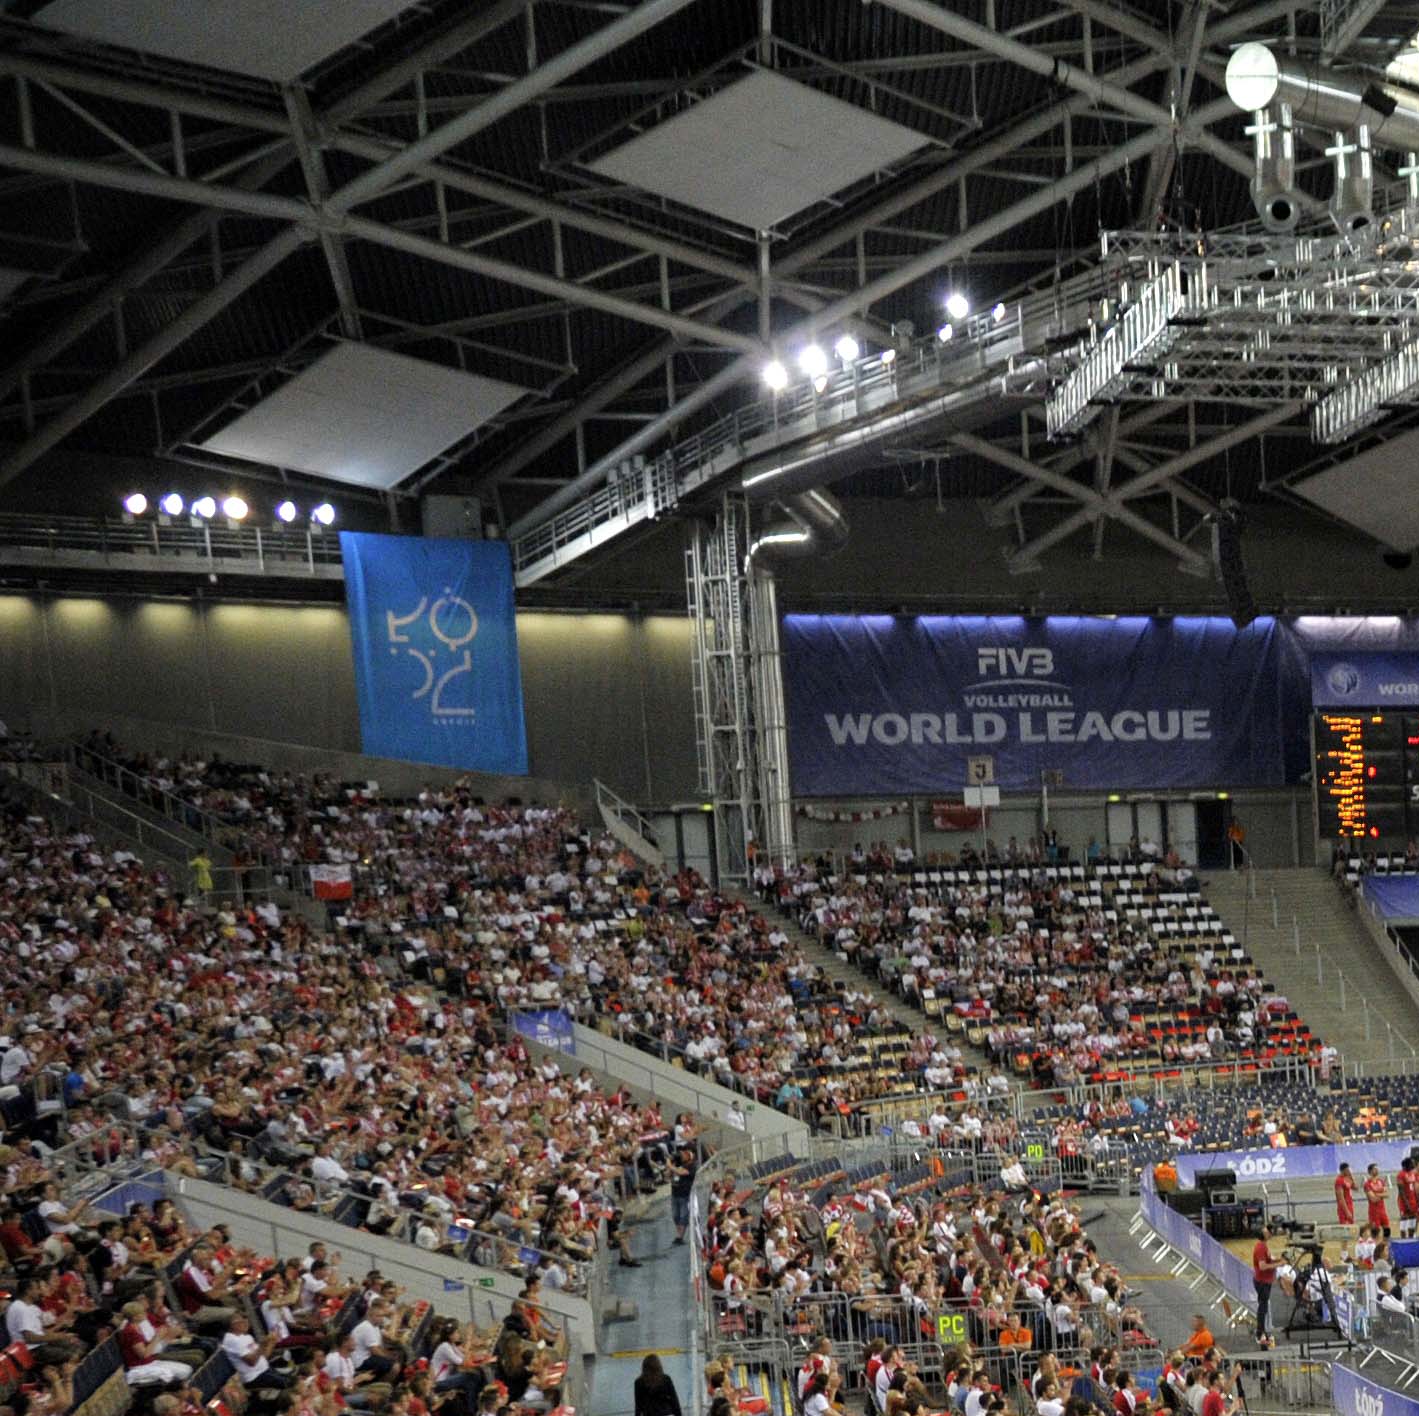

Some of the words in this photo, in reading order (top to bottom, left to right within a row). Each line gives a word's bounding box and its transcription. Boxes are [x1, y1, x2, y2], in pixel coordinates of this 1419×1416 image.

[977, 647, 1054, 676] FIVB
[963, 694, 1074, 709] VOLLEYBALL
[824, 712, 1008, 746] WORLD
[1018, 709, 1213, 743] LEAGUE
[1227, 1154, 1286, 1177] ŁÓDŹ
